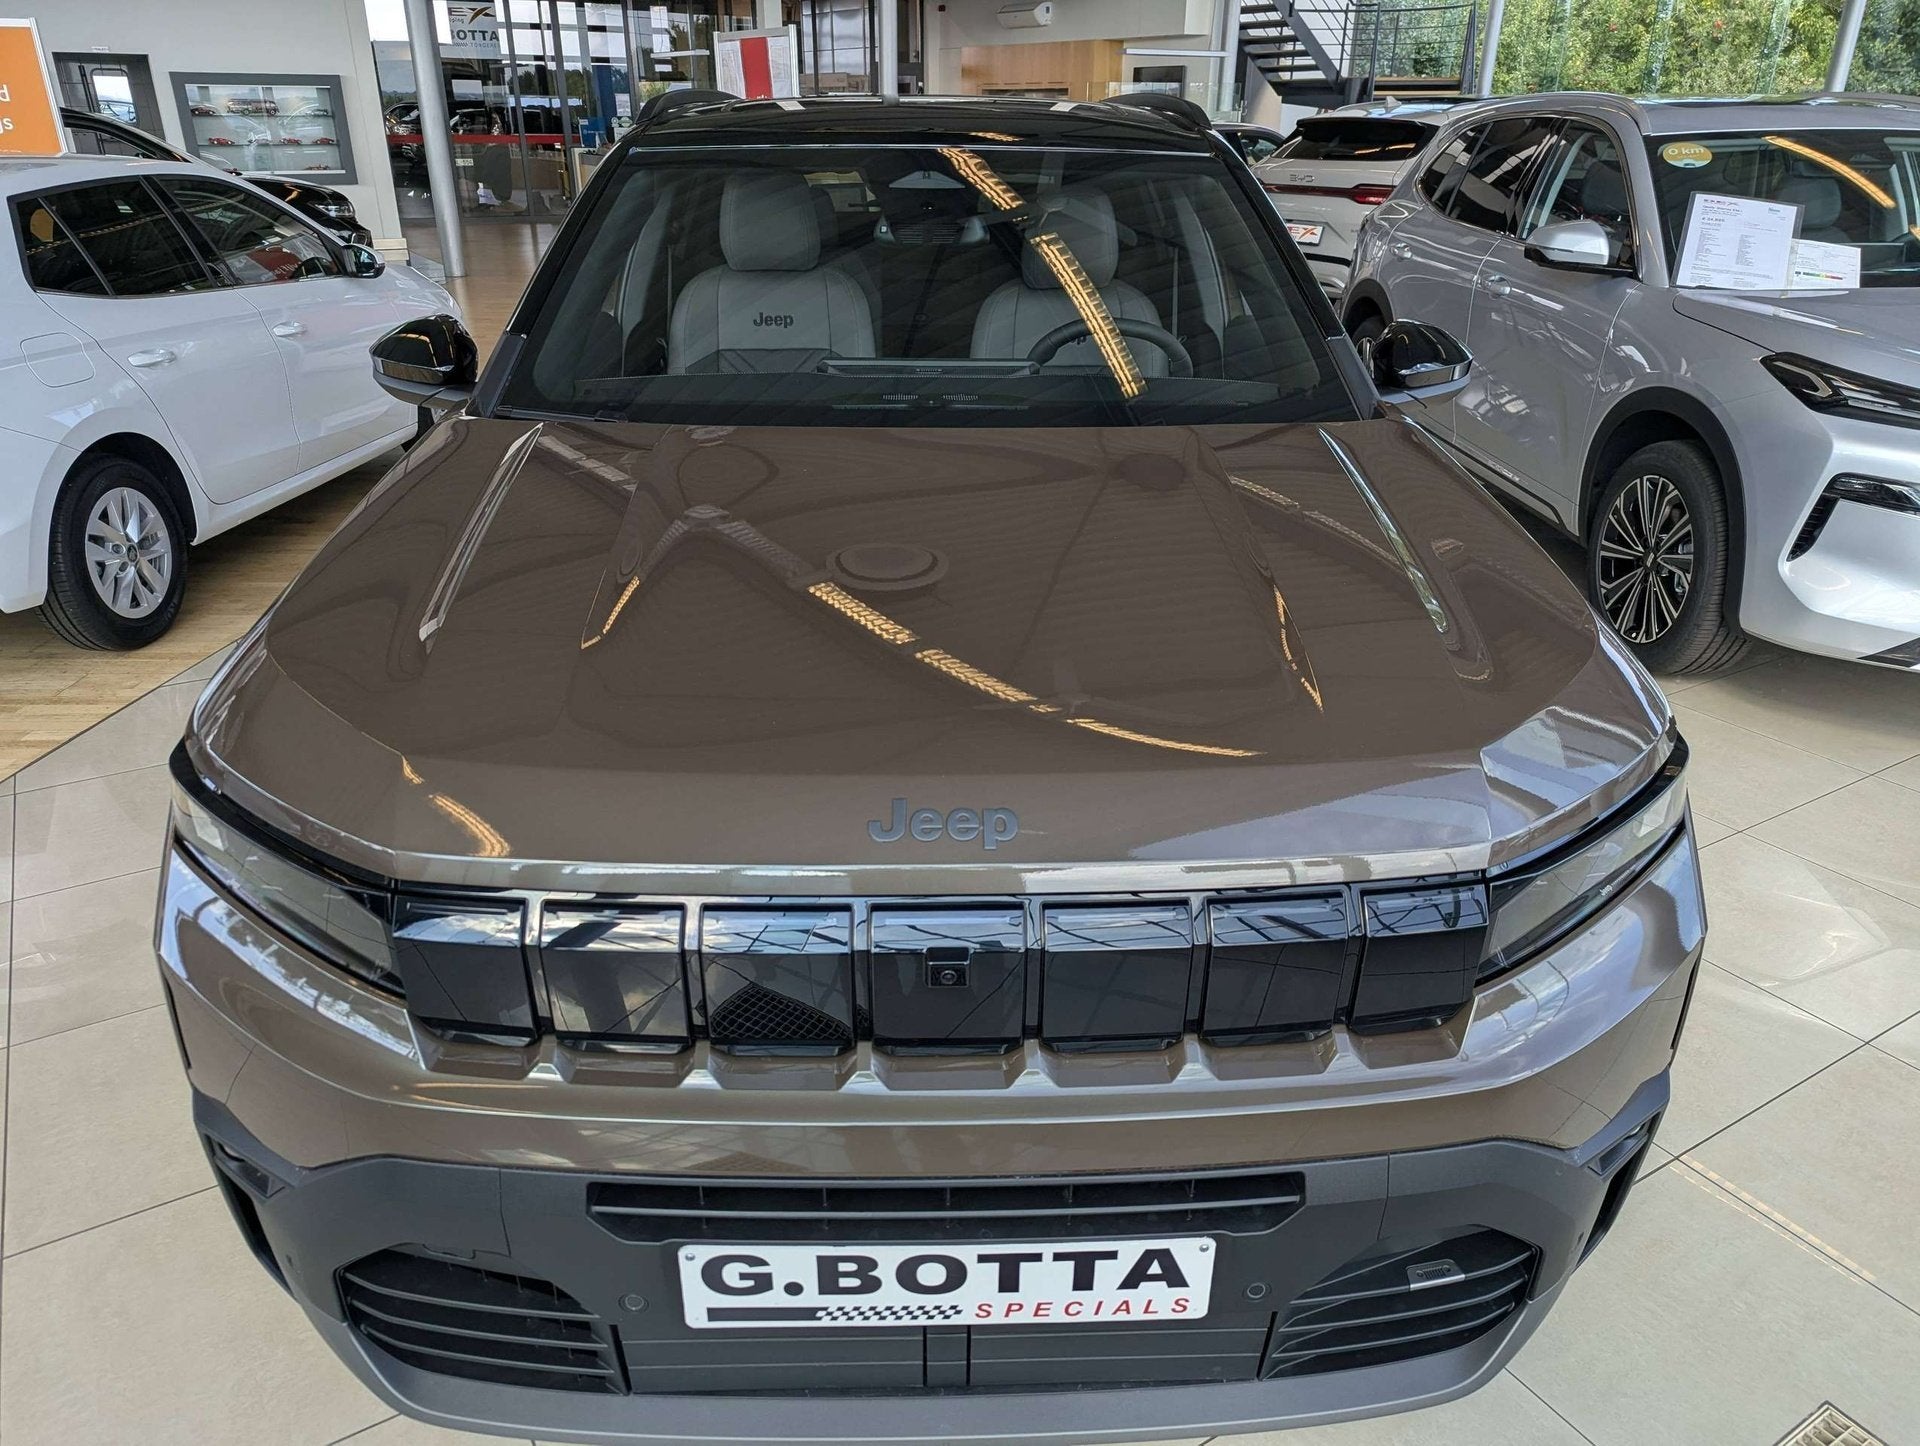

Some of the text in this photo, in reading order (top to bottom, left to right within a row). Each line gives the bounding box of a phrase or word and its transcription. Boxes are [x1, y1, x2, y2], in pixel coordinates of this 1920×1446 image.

[1681, 147, 1704, 155] km
[753, 311, 794, 328] Jeep
[868, 798, 1019, 850] Jeep
[700, 1248, 1190, 1297] G.BOTTA
[974, 1297, 1191, 1319] SPECIALS
